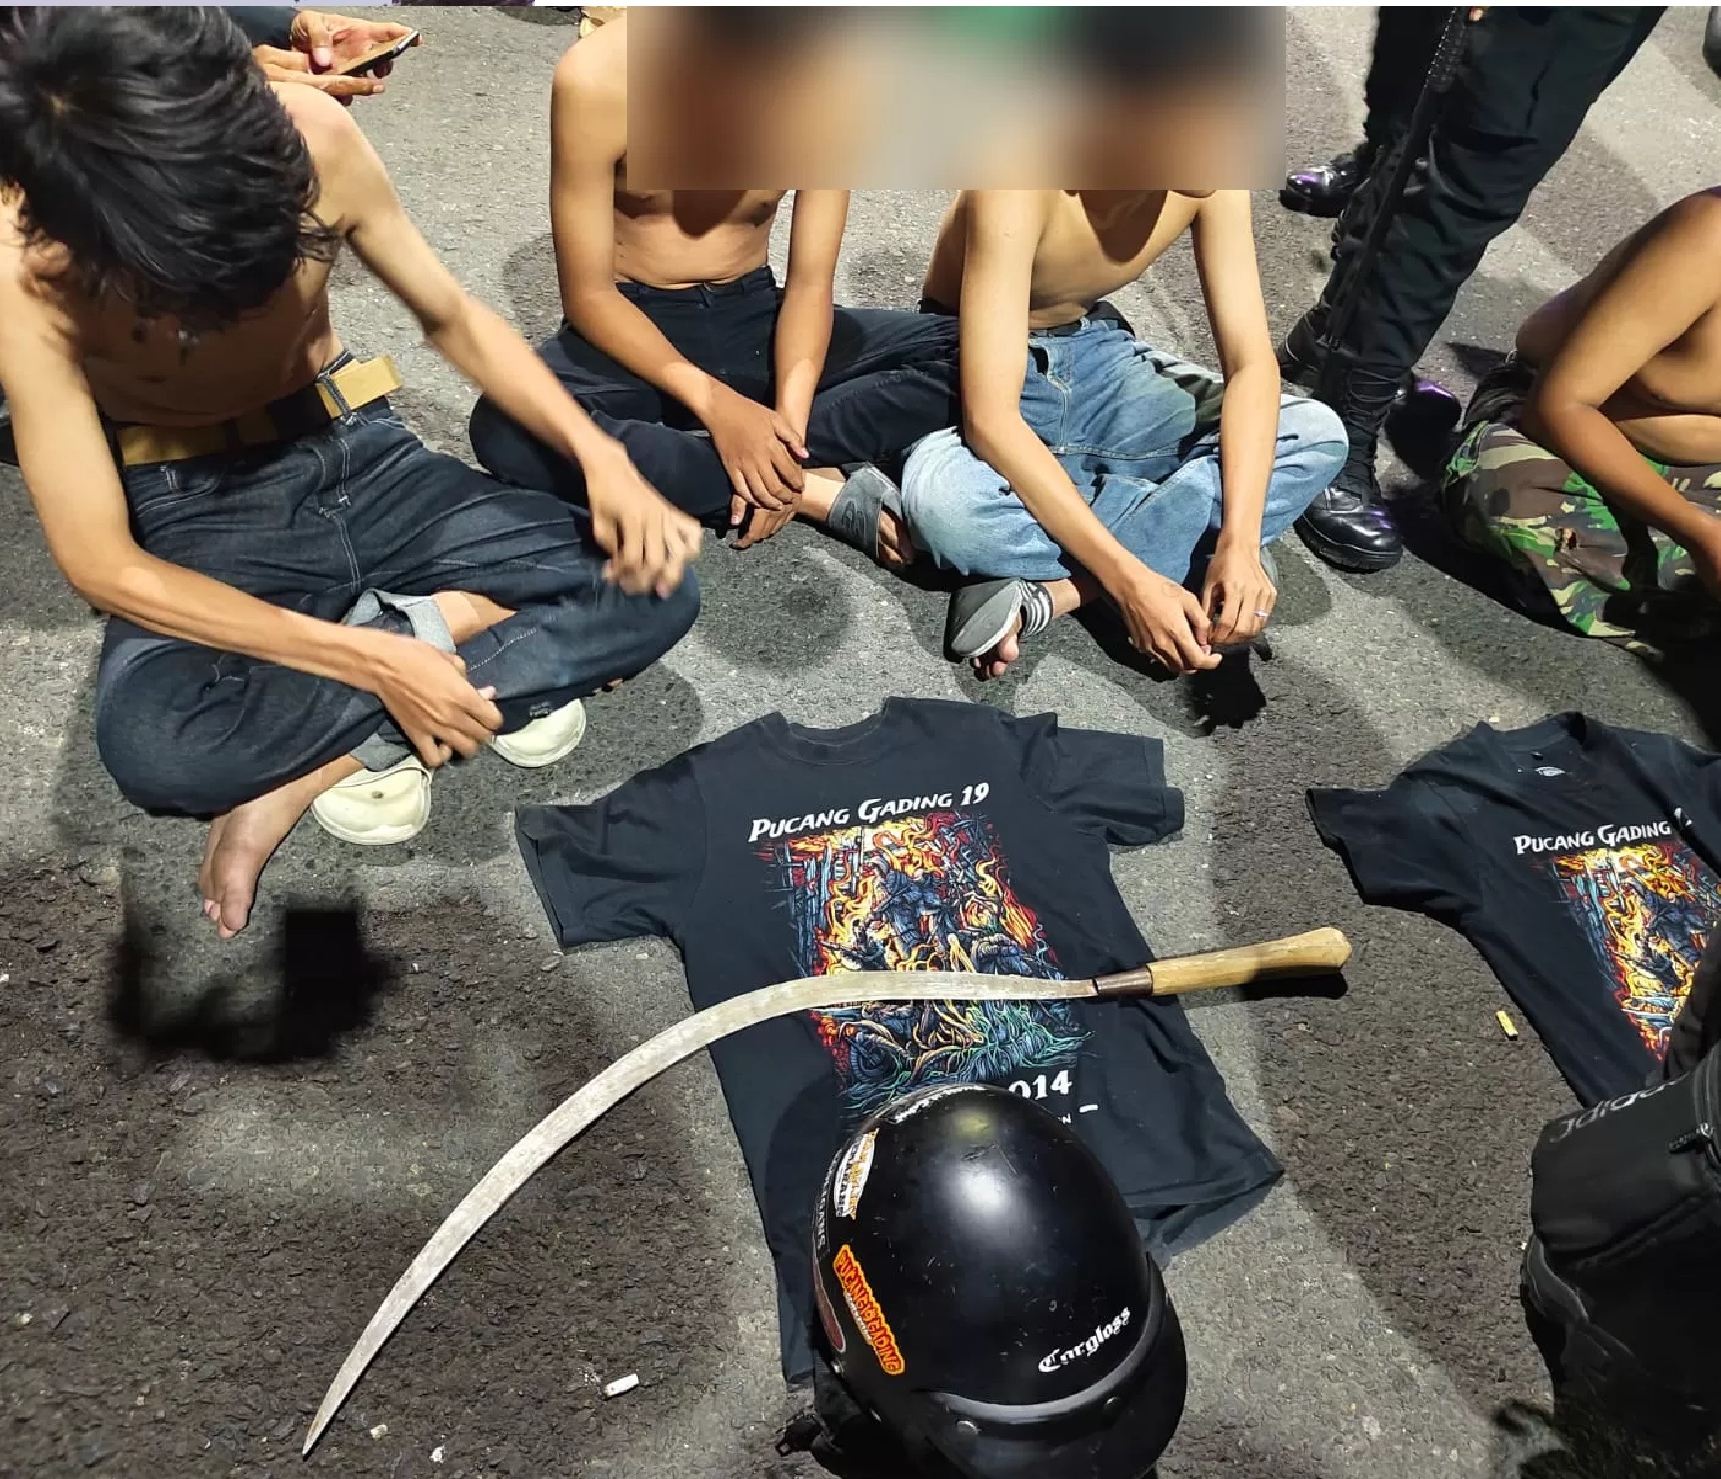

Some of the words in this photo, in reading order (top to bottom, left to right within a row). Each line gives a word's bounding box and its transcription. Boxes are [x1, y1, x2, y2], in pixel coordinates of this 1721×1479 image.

[748, 807, 849, 842] PUCANG
[858, 791, 952, 820] GADING
[961, 782, 990, 805] 19
[1513, 829, 1594, 855] PUCANG
[1597, 820, 1671, 848] GADING
